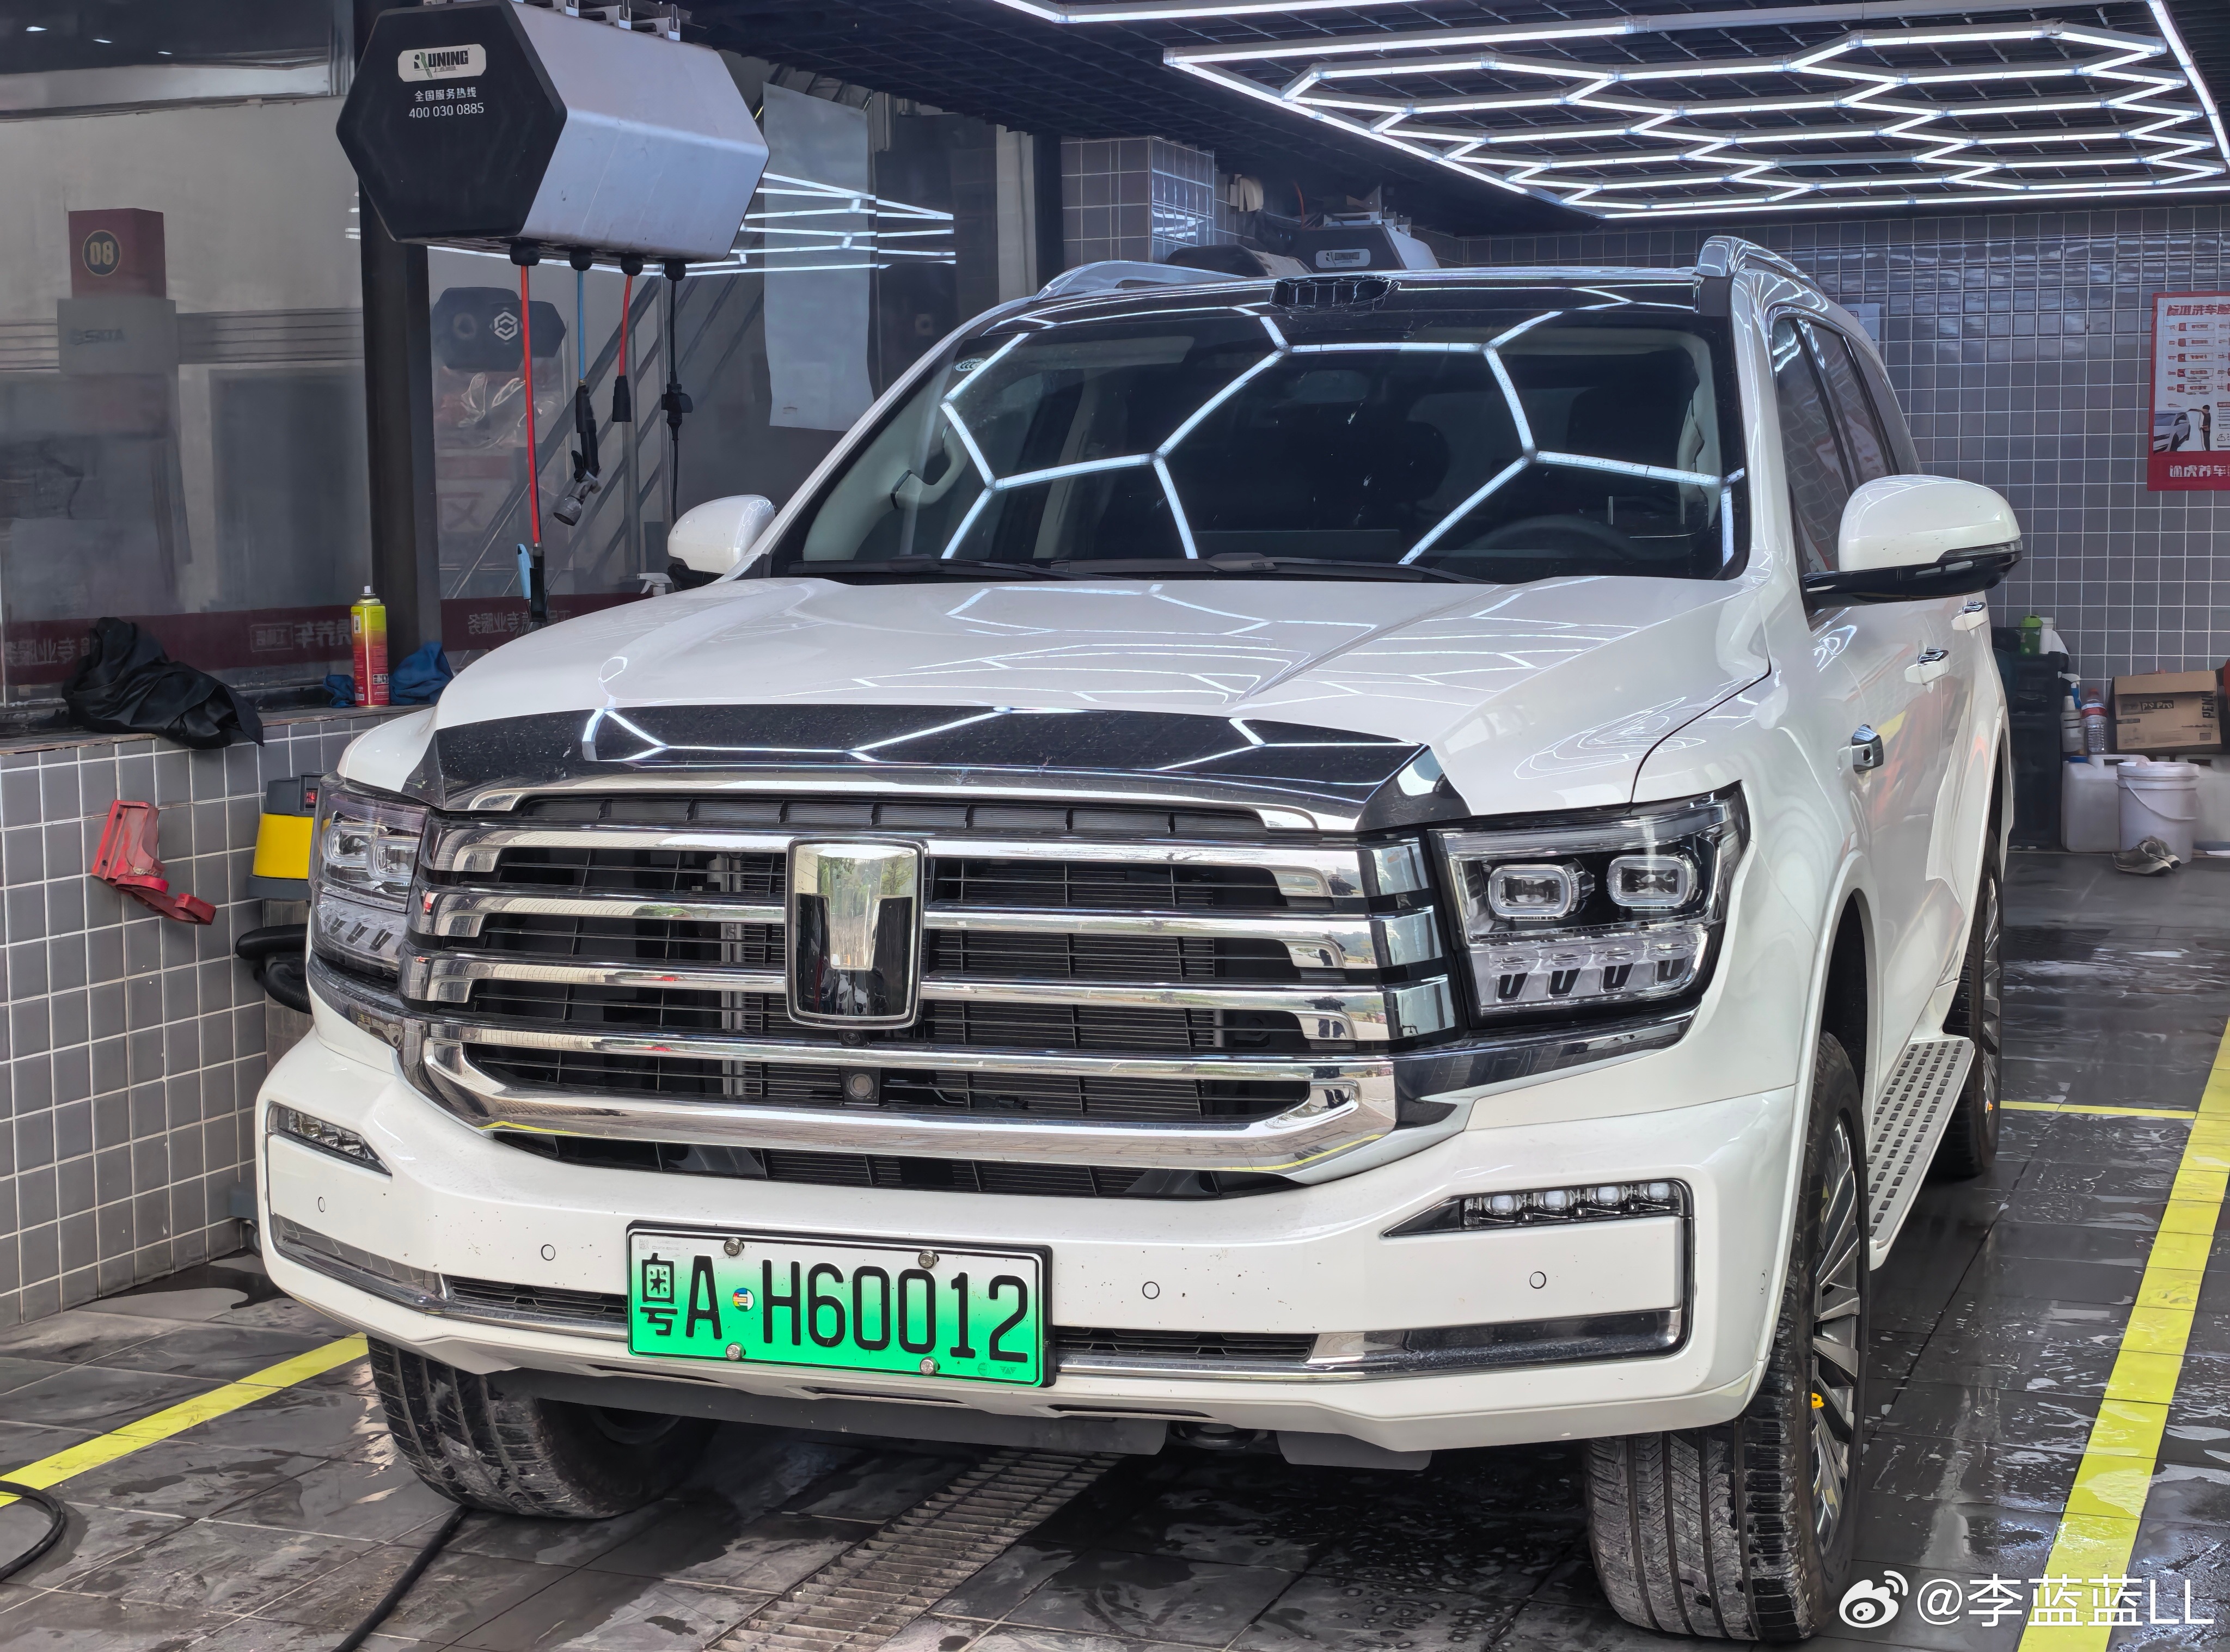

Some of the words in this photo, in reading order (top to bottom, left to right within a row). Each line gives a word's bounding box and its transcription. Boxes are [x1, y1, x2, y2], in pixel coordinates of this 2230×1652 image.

[415, 87, 477, 102] 全国服务热线
[409, 107, 430, 118] 400
[433, 105, 454, 117] 030
[457, 102, 484, 115] 0885
[89, 242, 114, 265] 08
[640, 1252, 722, 1339] 粤A
[762, 1259, 1028, 1363] H60012
